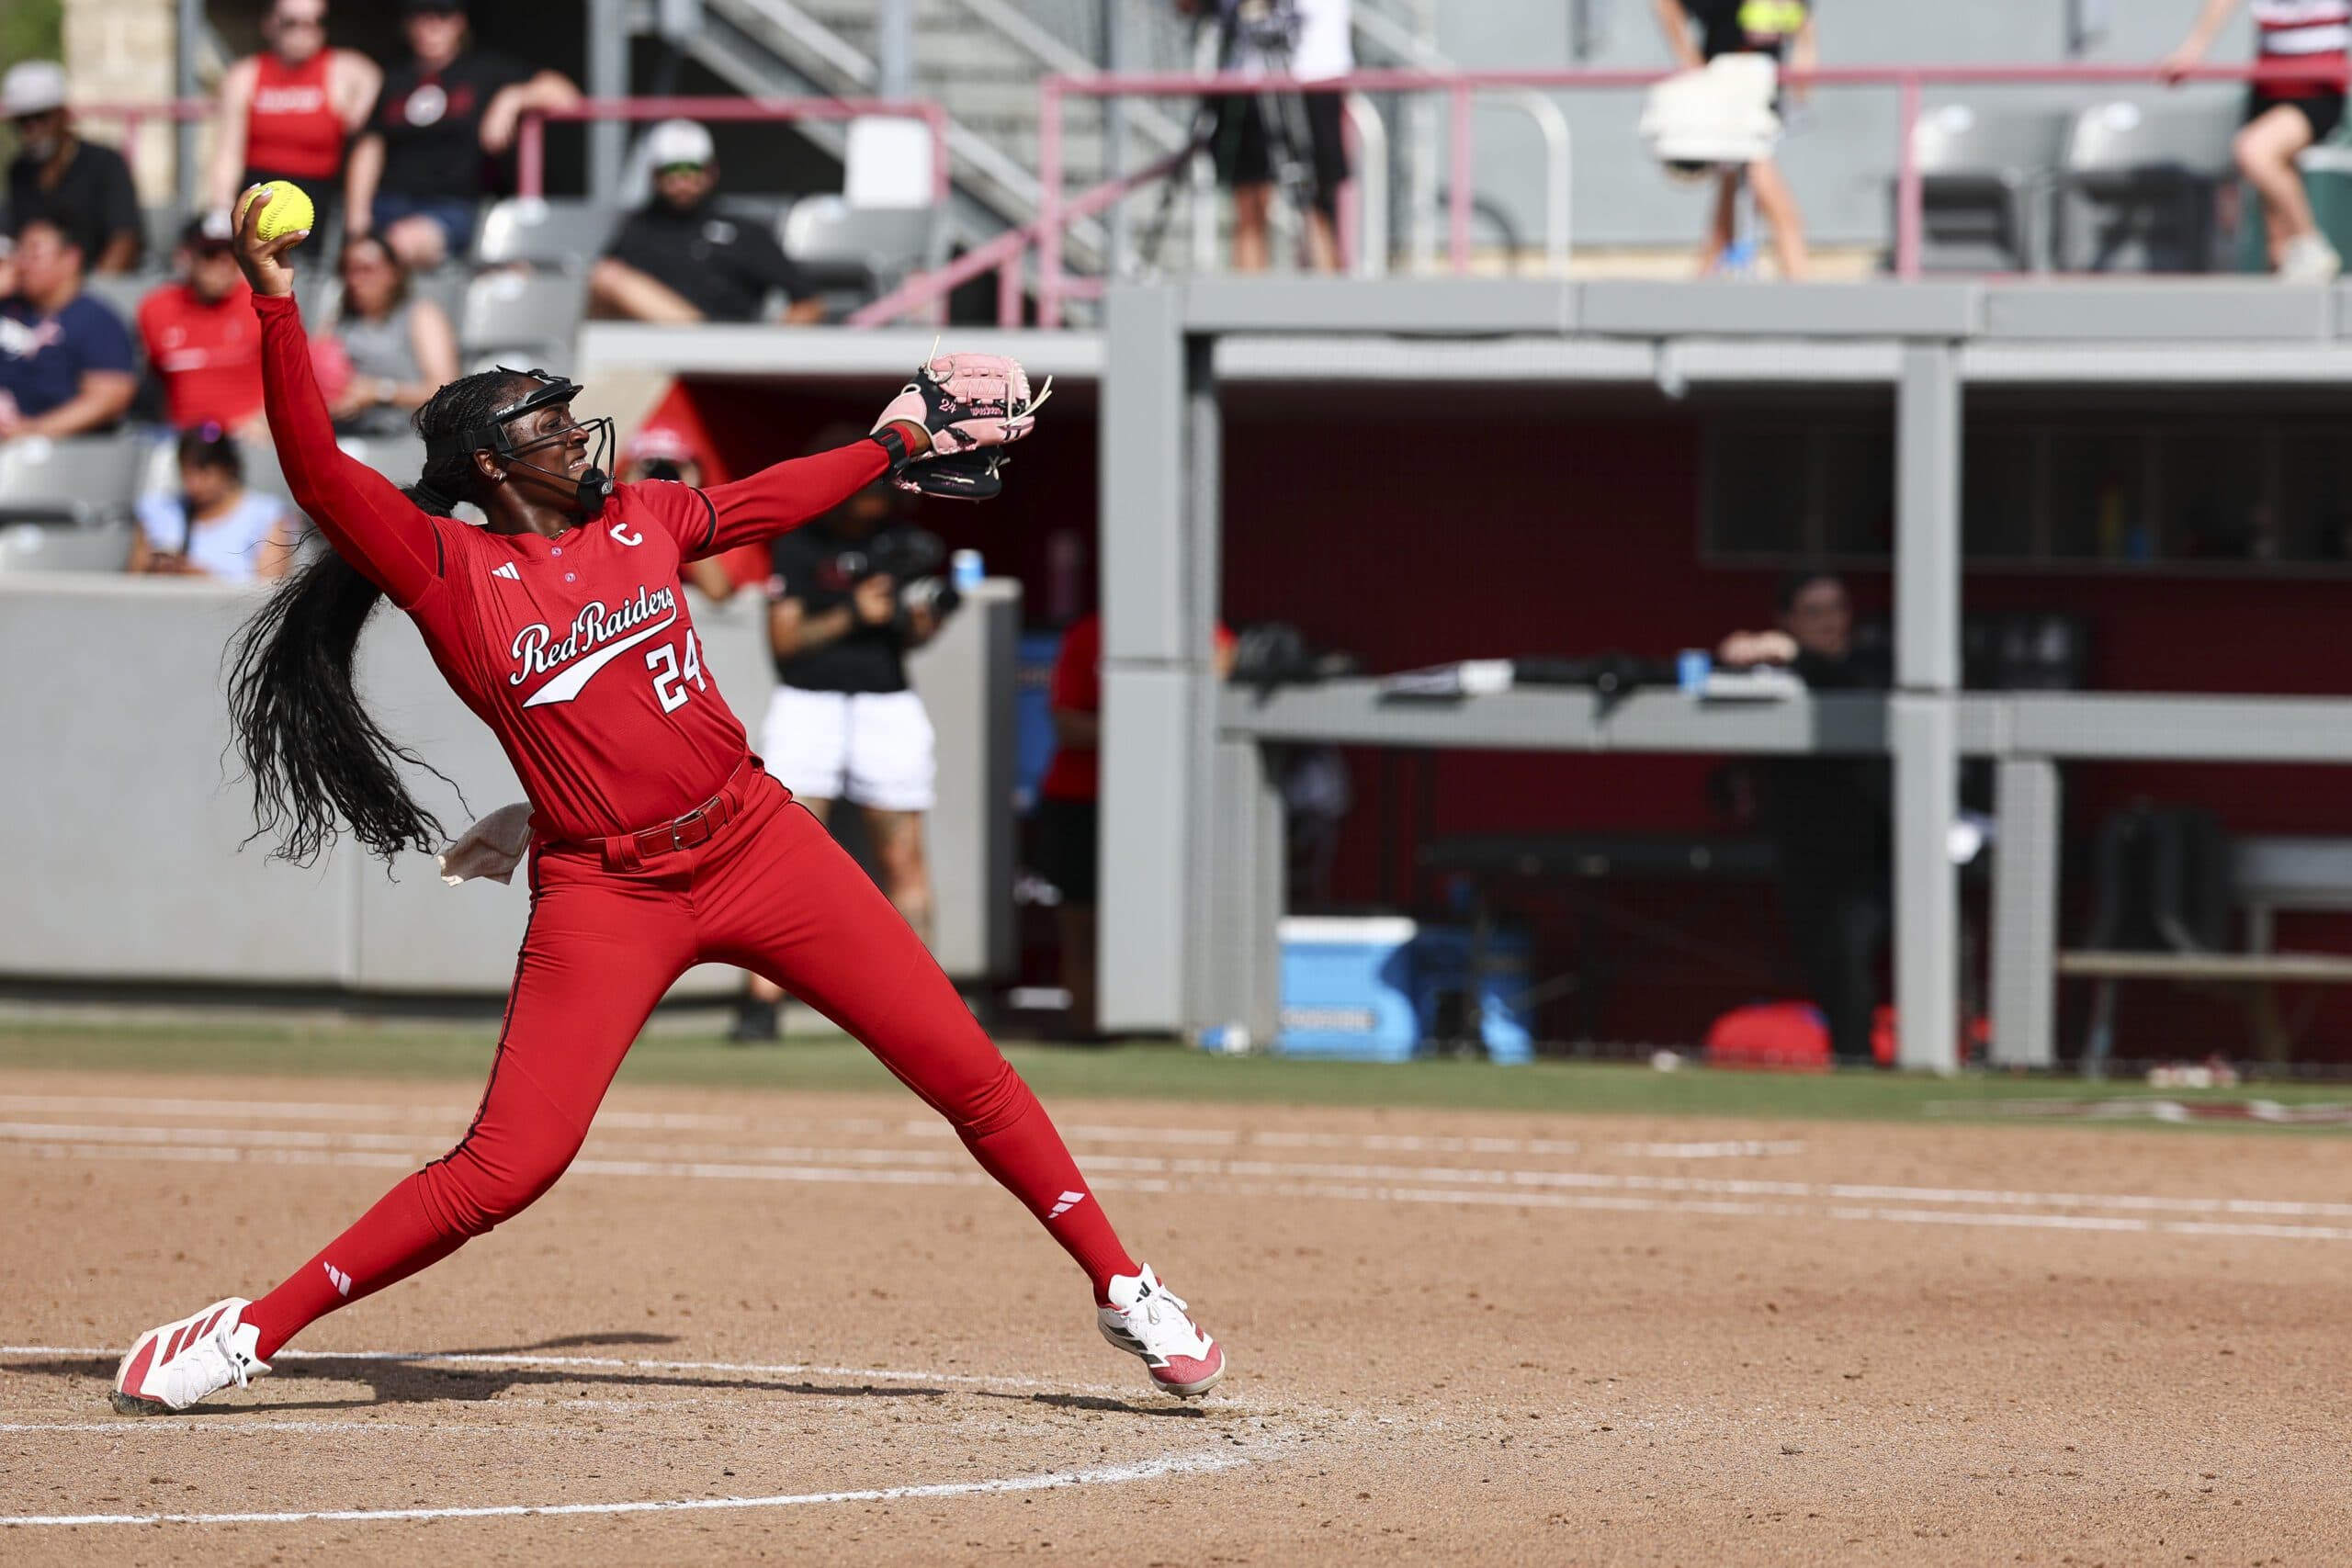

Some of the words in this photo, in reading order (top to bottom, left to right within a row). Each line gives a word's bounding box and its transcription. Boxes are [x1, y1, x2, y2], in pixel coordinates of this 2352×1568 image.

[938, 398, 956, 413] 24
[610, 523, 642, 546] C
[645, 628, 707, 714] 24
